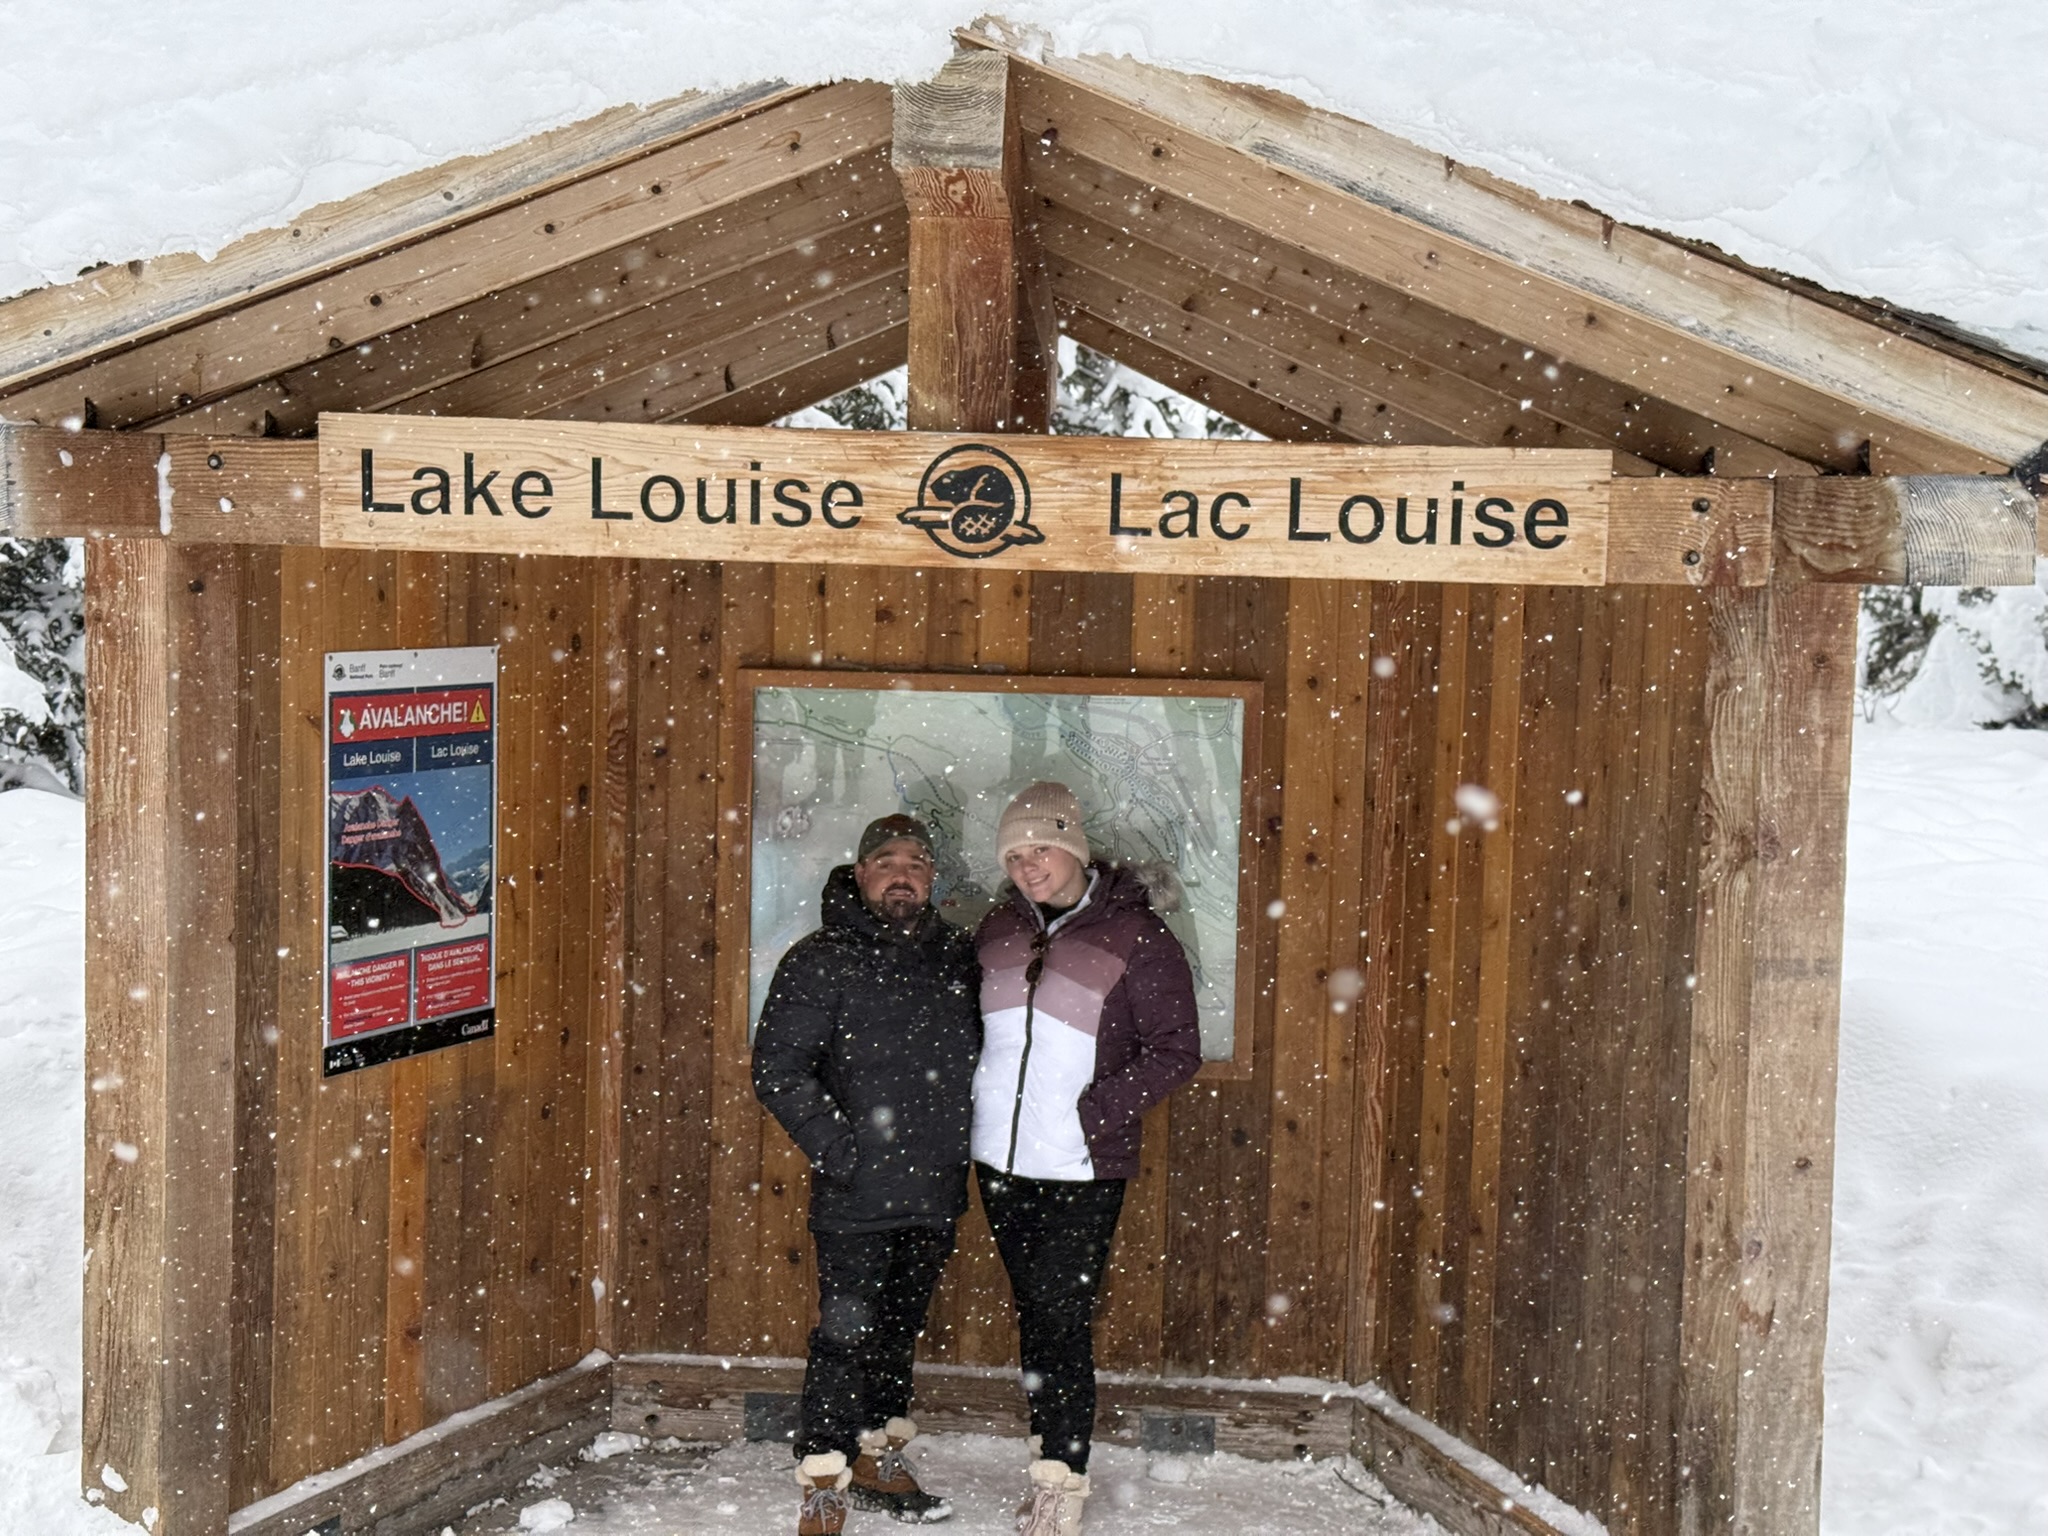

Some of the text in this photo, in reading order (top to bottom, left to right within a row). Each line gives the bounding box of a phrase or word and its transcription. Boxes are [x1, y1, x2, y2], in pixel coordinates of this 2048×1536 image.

[361, 448, 864, 529] Lake Louise
[1109, 471, 1570, 550] Lac Louise
[349, 663, 366, 673] Banff
[379, 669, 396, 679] Banff
[359, 701, 468, 730] AVALANCHE!
[343, 750, 402, 767] Lake Louise
[431, 743, 480, 759] Lac Louise
[372, 960, 397, 973] DANGER
